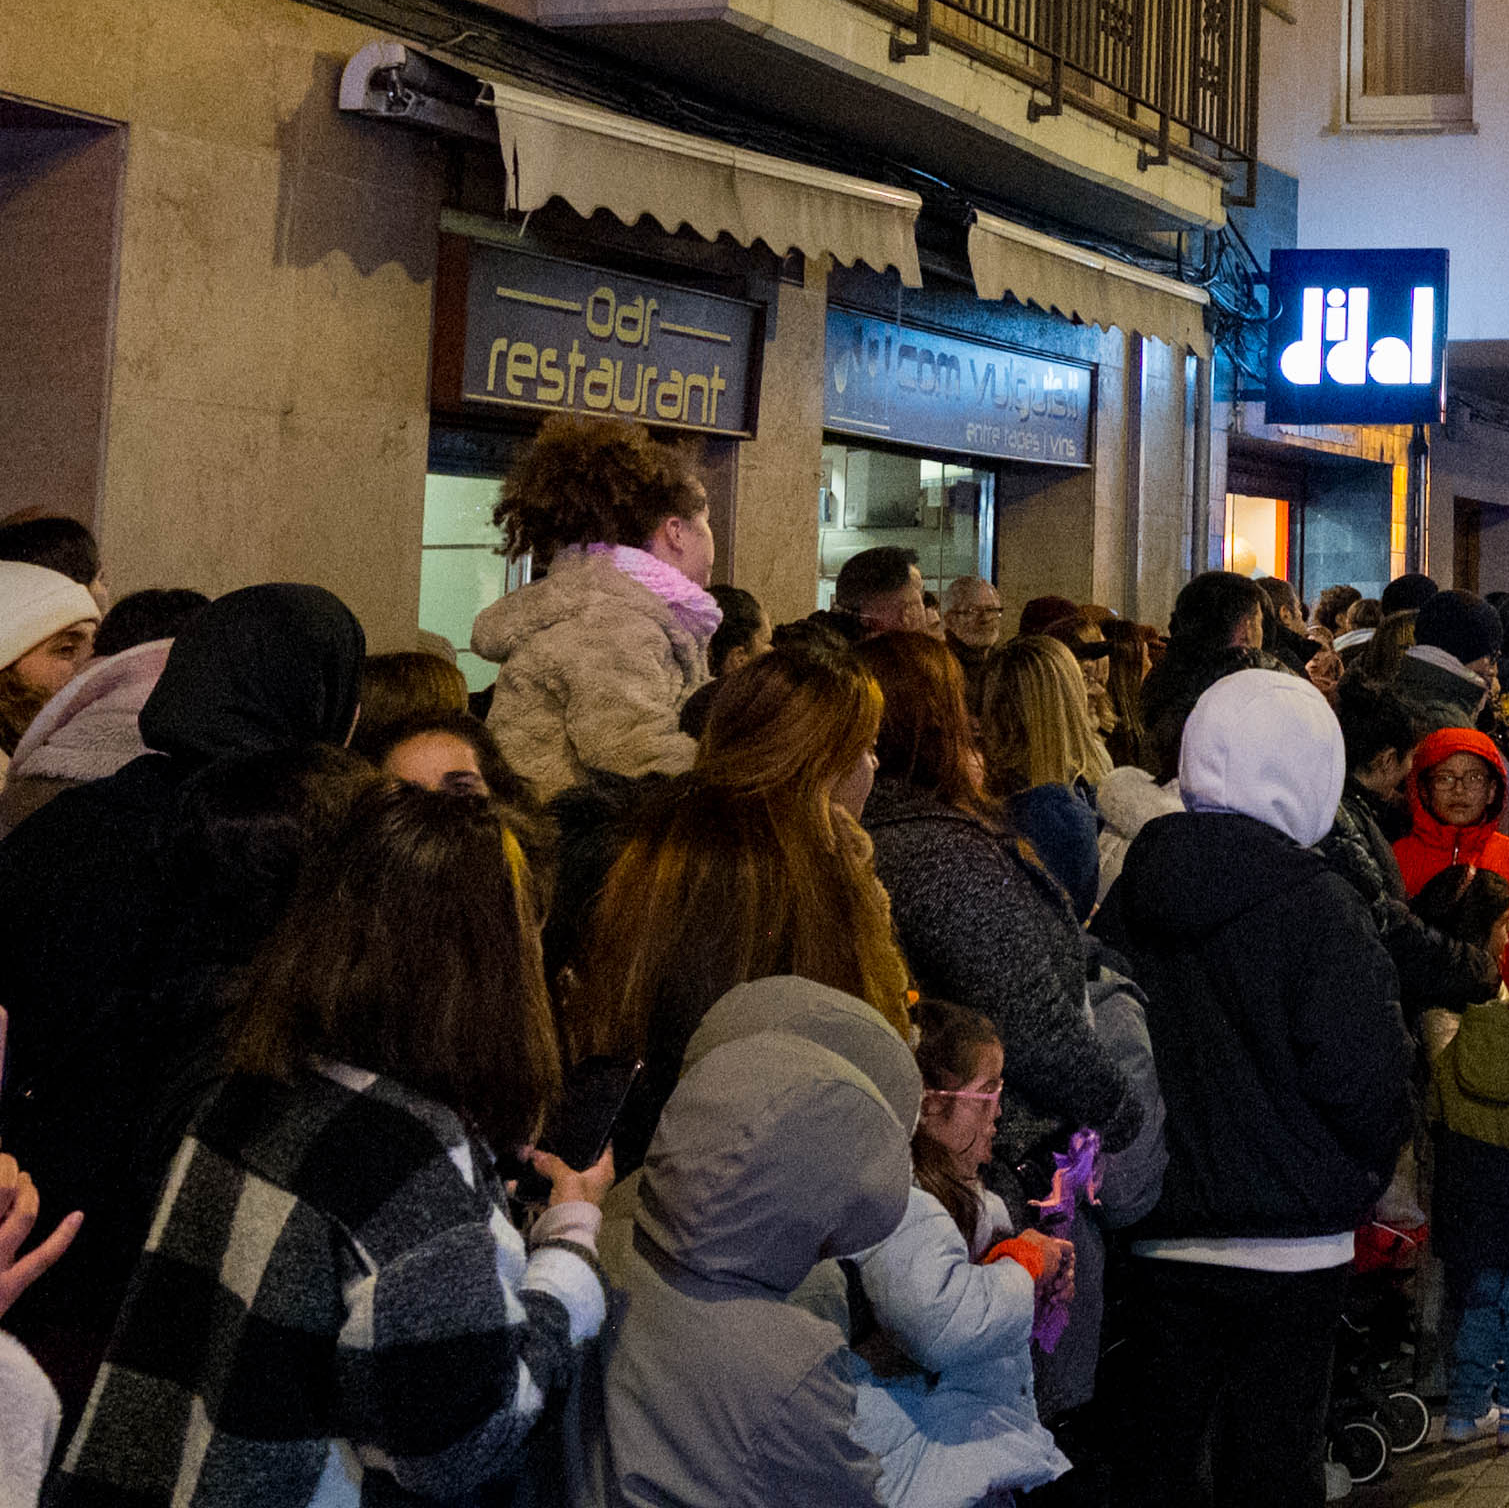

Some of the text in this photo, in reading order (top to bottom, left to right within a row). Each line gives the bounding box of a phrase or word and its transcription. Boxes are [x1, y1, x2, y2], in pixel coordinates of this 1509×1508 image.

[486, 336, 727, 426] restaurant
[966, 422, 1001, 443] entre
[1050, 434, 1077, 457] vins
